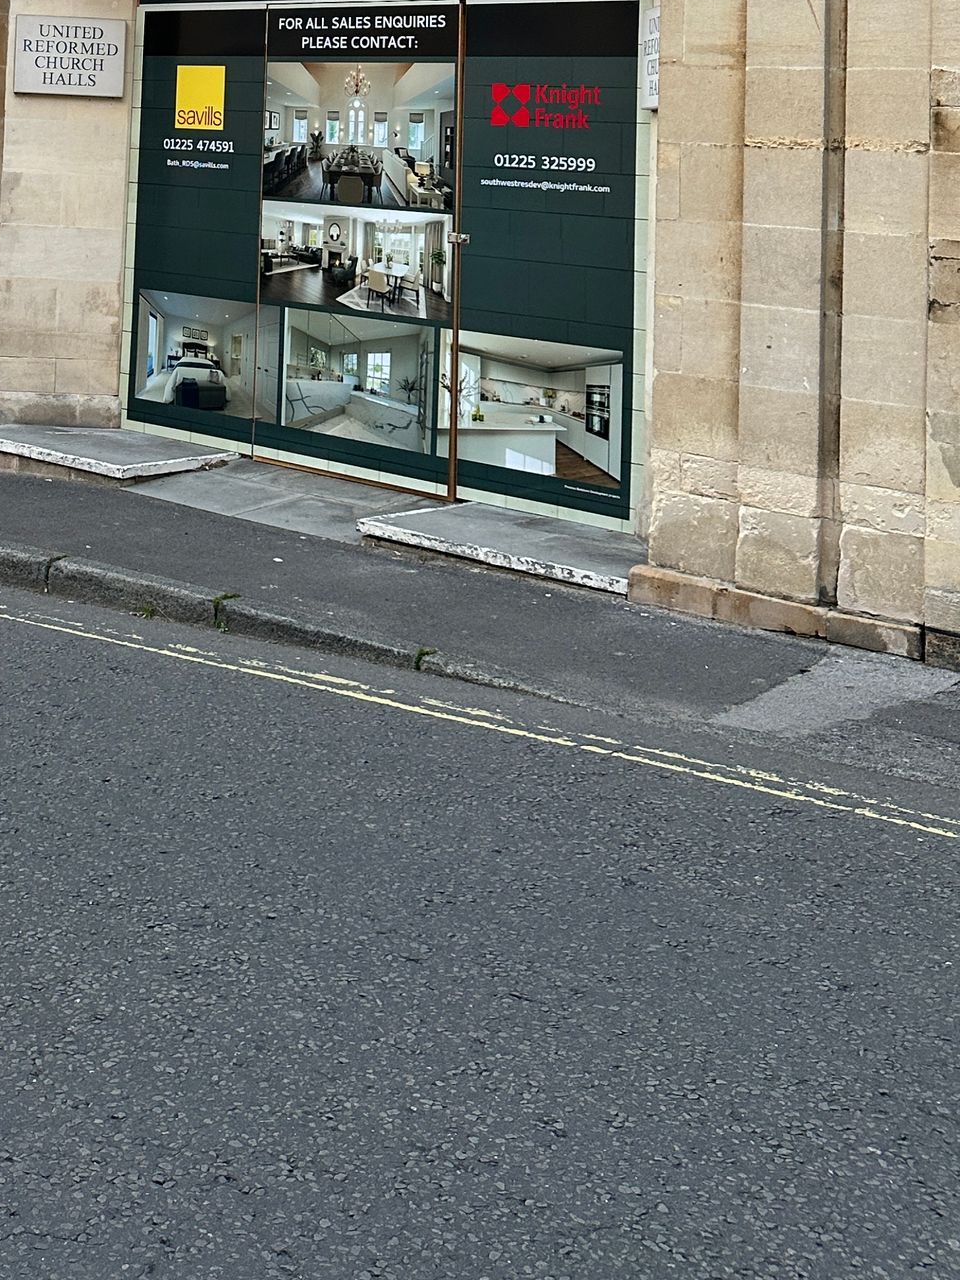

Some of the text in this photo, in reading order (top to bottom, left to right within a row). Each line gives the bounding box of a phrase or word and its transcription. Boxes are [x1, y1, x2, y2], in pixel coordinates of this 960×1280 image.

[279, 15, 446, 29] FOR ALL SALES ENQUIRIES
[39, 24, 104, 39] UNITED
[23, 39, 118, 56] REFORMED
[302, 36, 417, 48] PLEASE CONTACT:
[35, 56, 104, 71] CHURCH
[42, 72, 96, 86] HALLS
[535, 84, 601, 109] Knight
[176, 105, 224, 127] savills
[535, 108, 589, 128] Frank
[164, 139, 234, 152] 01225 474591
[494, 154, 595, 171] 01225 325999
[481, 179, 610, 192] southwestresdev@knightfrank.com
